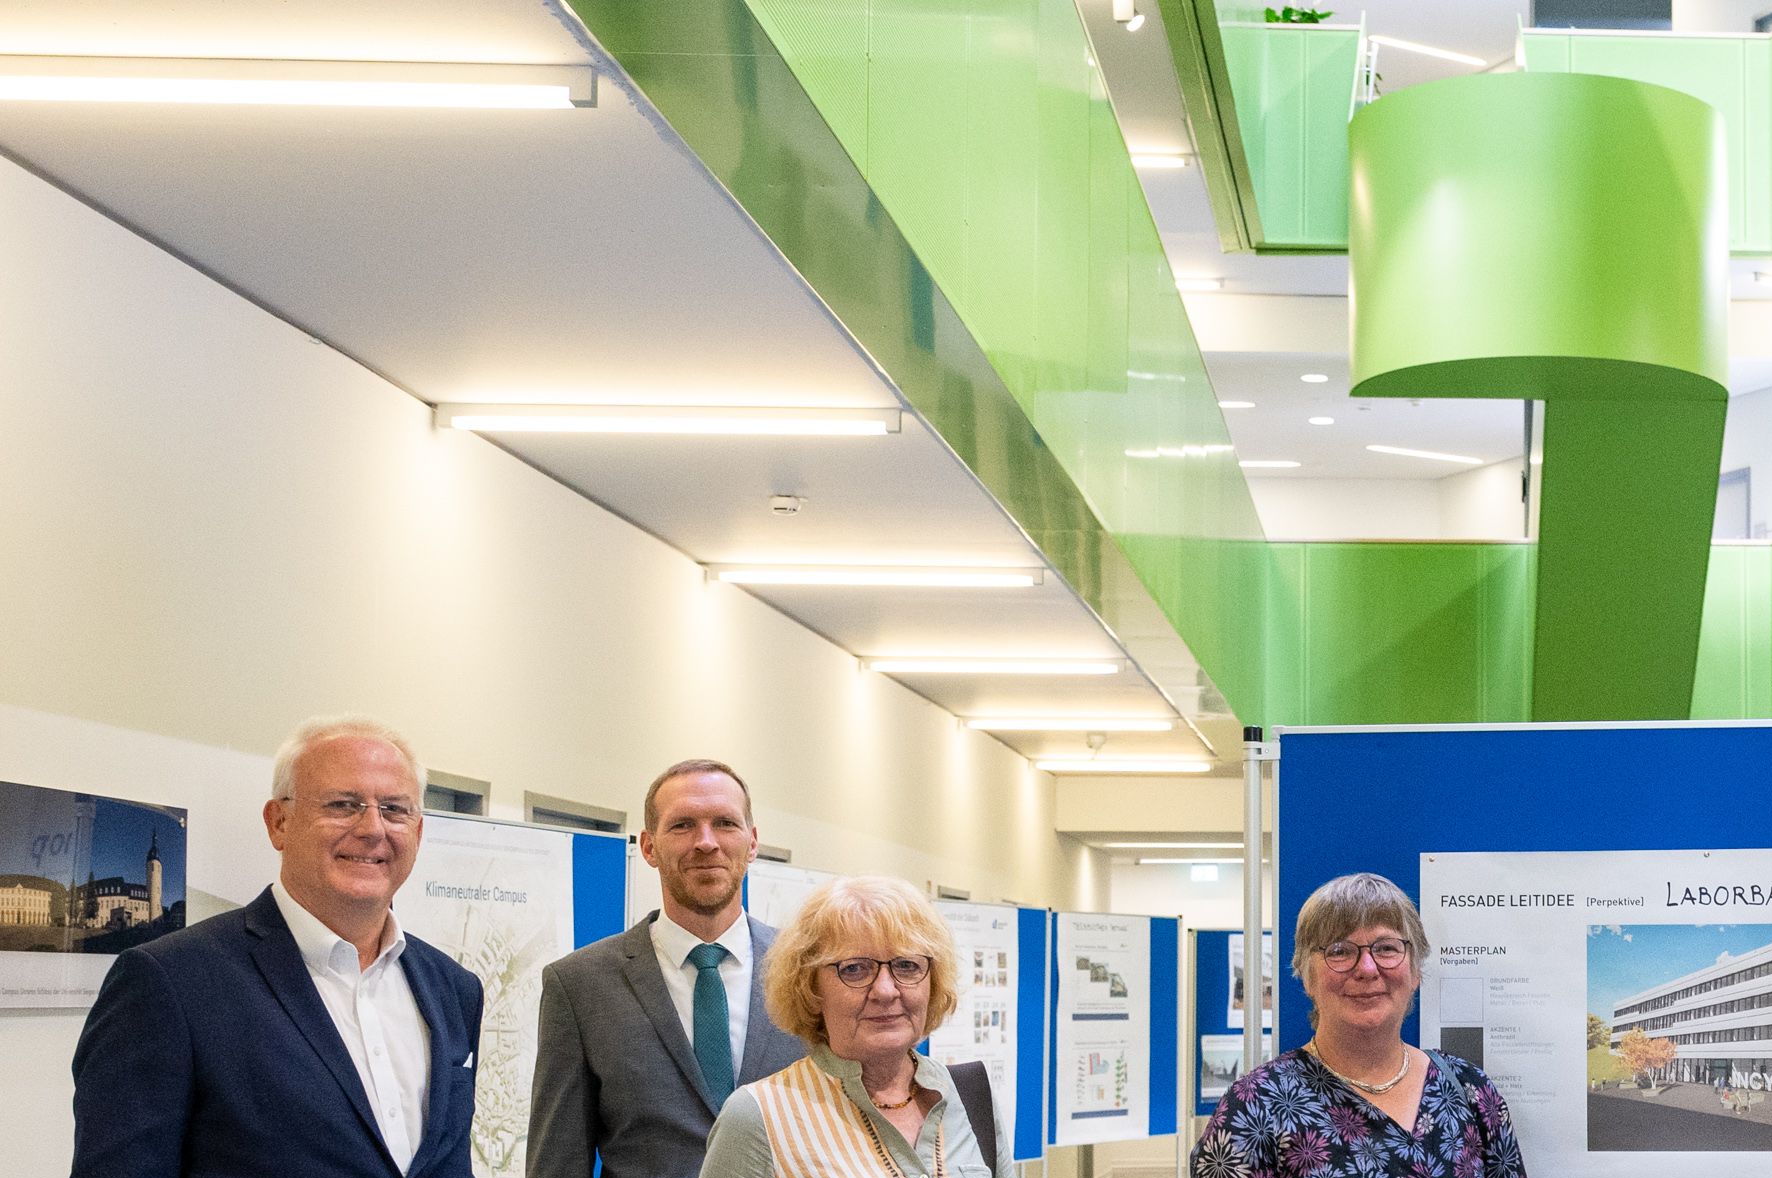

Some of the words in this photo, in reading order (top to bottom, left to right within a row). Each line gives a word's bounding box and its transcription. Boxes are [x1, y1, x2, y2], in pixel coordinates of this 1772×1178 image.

[426, 881, 491, 901] Klimaneutraler
[493, 886, 527, 905] Campus
[1440, 895, 1505, 907] FASSADE
[1510, 894, 1575, 907] LEITIDEE
[1586, 897, 1644, 908] [Perpektive]
[1440, 946, 1507, 955] MASTERPLAN
[1440, 957, 1479, 965] [Vorgaben]
